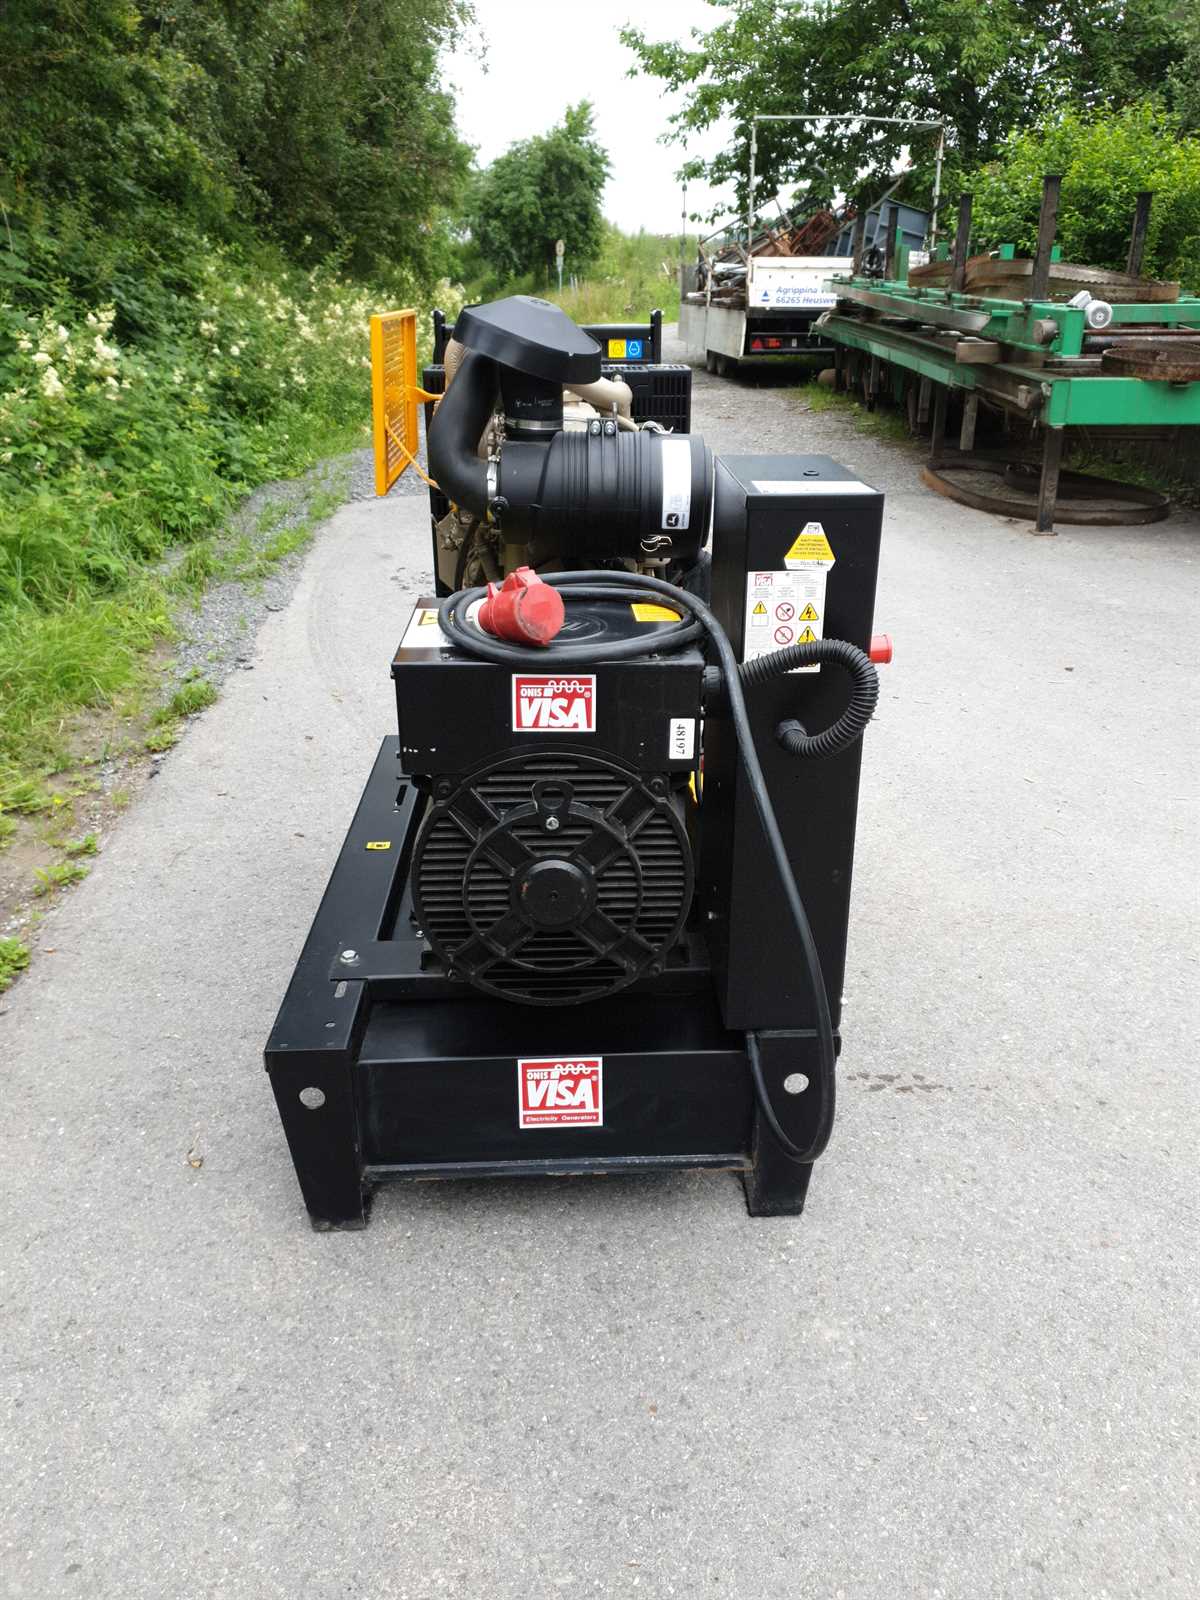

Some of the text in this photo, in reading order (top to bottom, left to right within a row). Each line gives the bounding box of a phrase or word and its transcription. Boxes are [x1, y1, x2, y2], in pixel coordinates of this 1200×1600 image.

[776, 287, 818, 295] Agrippina
[776, 296, 800, 304] 66265
[521, 688, 542, 697] ONIS
[520, 698, 588, 728] VISA
[675, 723, 686, 755] 48197
[527, 1072, 548, 1080] ONIS
[527, 1079, 594, 1111] VISA
